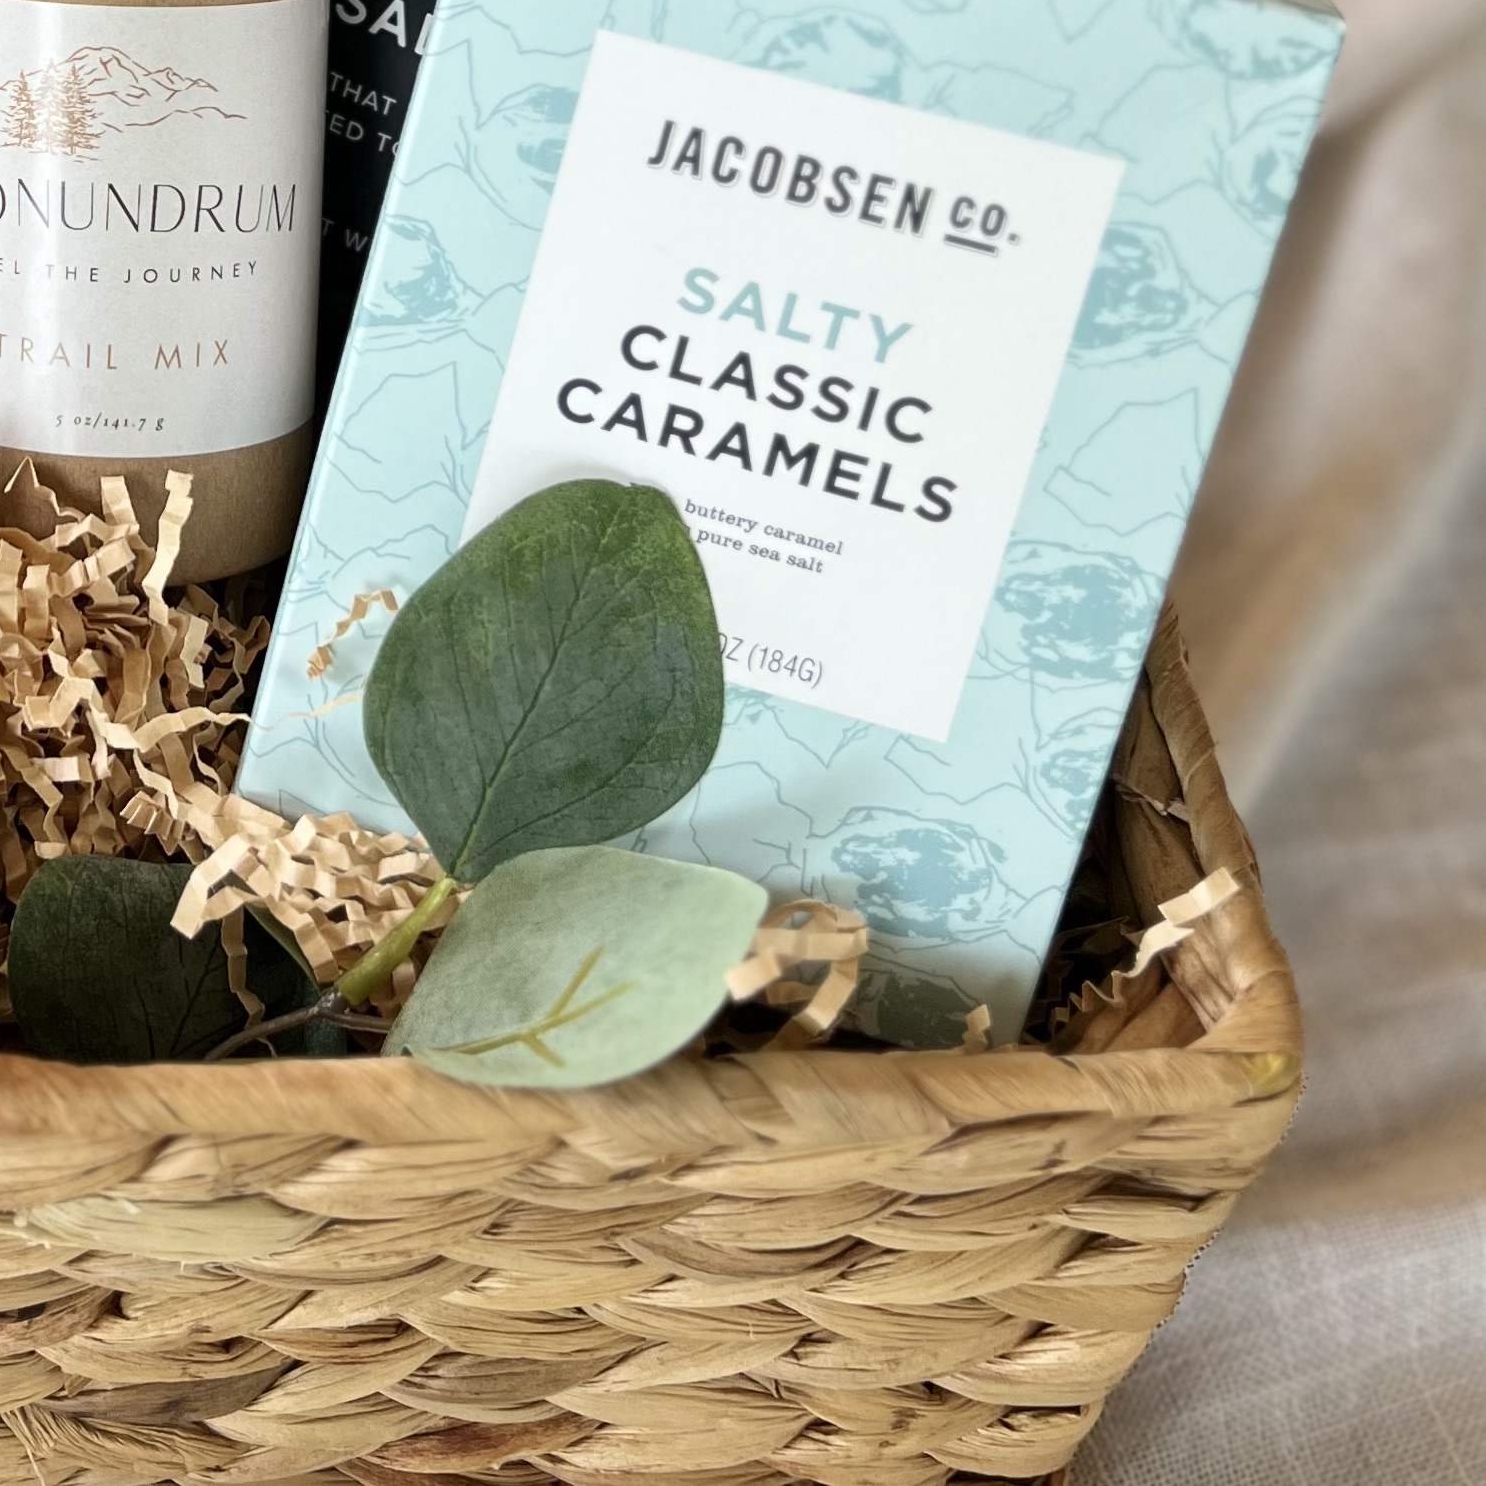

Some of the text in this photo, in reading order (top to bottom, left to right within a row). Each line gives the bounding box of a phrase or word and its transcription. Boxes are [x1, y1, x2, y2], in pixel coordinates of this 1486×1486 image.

[330, 71, 398, 115] THAT
[325, 110, 365, 141] ED
[647, 119, 935, 238] JACOBSEN
[46, 263, 99, 283] THE
[124, 260, 257, 285] JOURNEY
[676, 266, 914, 365] SALTY
[154, 339, 229, 370] MIX
[620, 324, 934, 445] CLASSIC
[55, 415, 64, 428] 5
[556, 377, 960, 524] CARAMELS
[684, 498, 844, 555] buttery caramel
[695, 528, 825, 574] pure sea salt
[747, 643, 823, 689] (184G)
